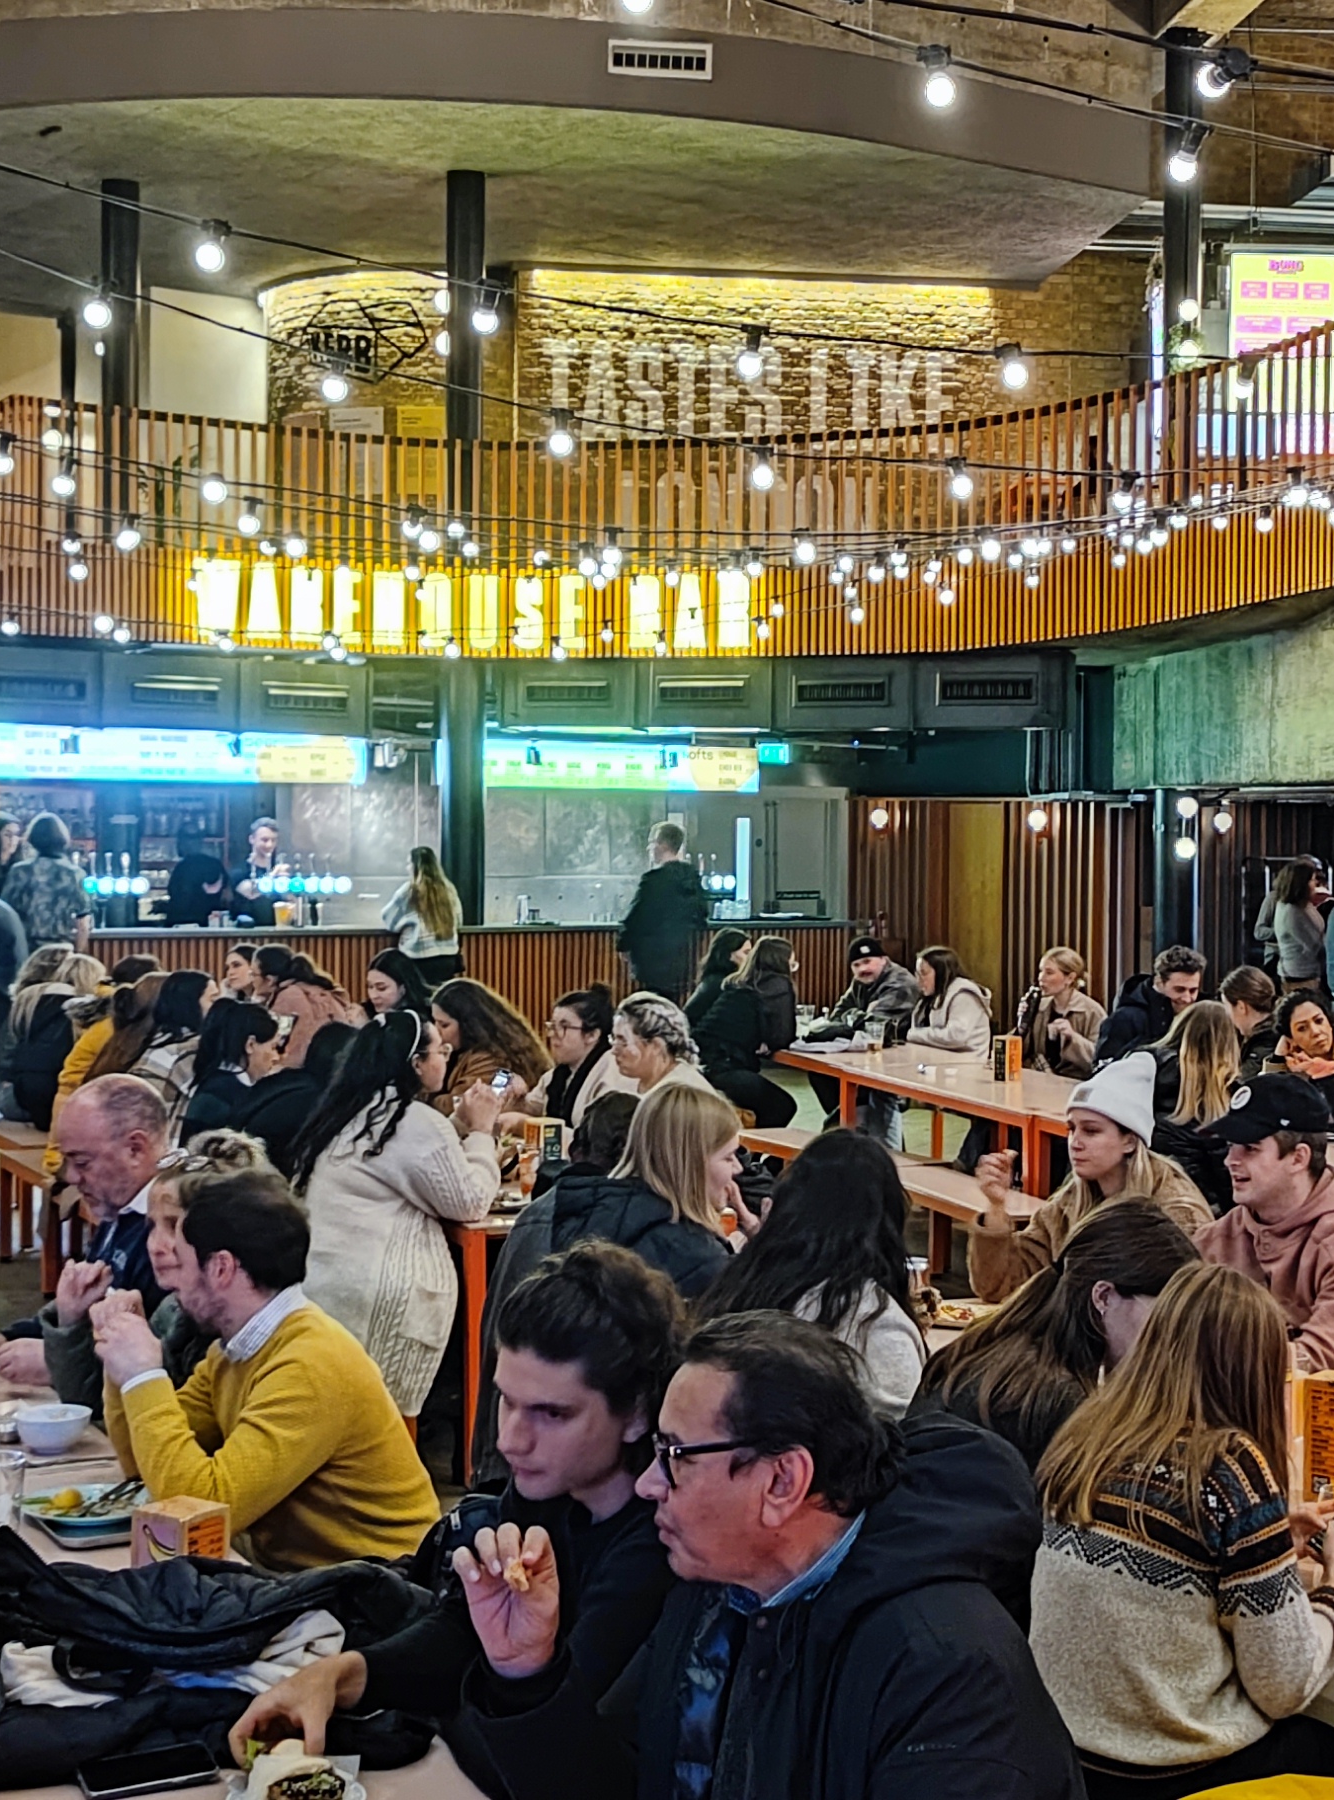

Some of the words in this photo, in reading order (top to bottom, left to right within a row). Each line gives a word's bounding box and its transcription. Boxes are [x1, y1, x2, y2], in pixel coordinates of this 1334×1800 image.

[534, 338, 784, 446] TASTES
[193, 558, 586, 649] WAREHOUSE
[629, 571, 751, 649] BAR
